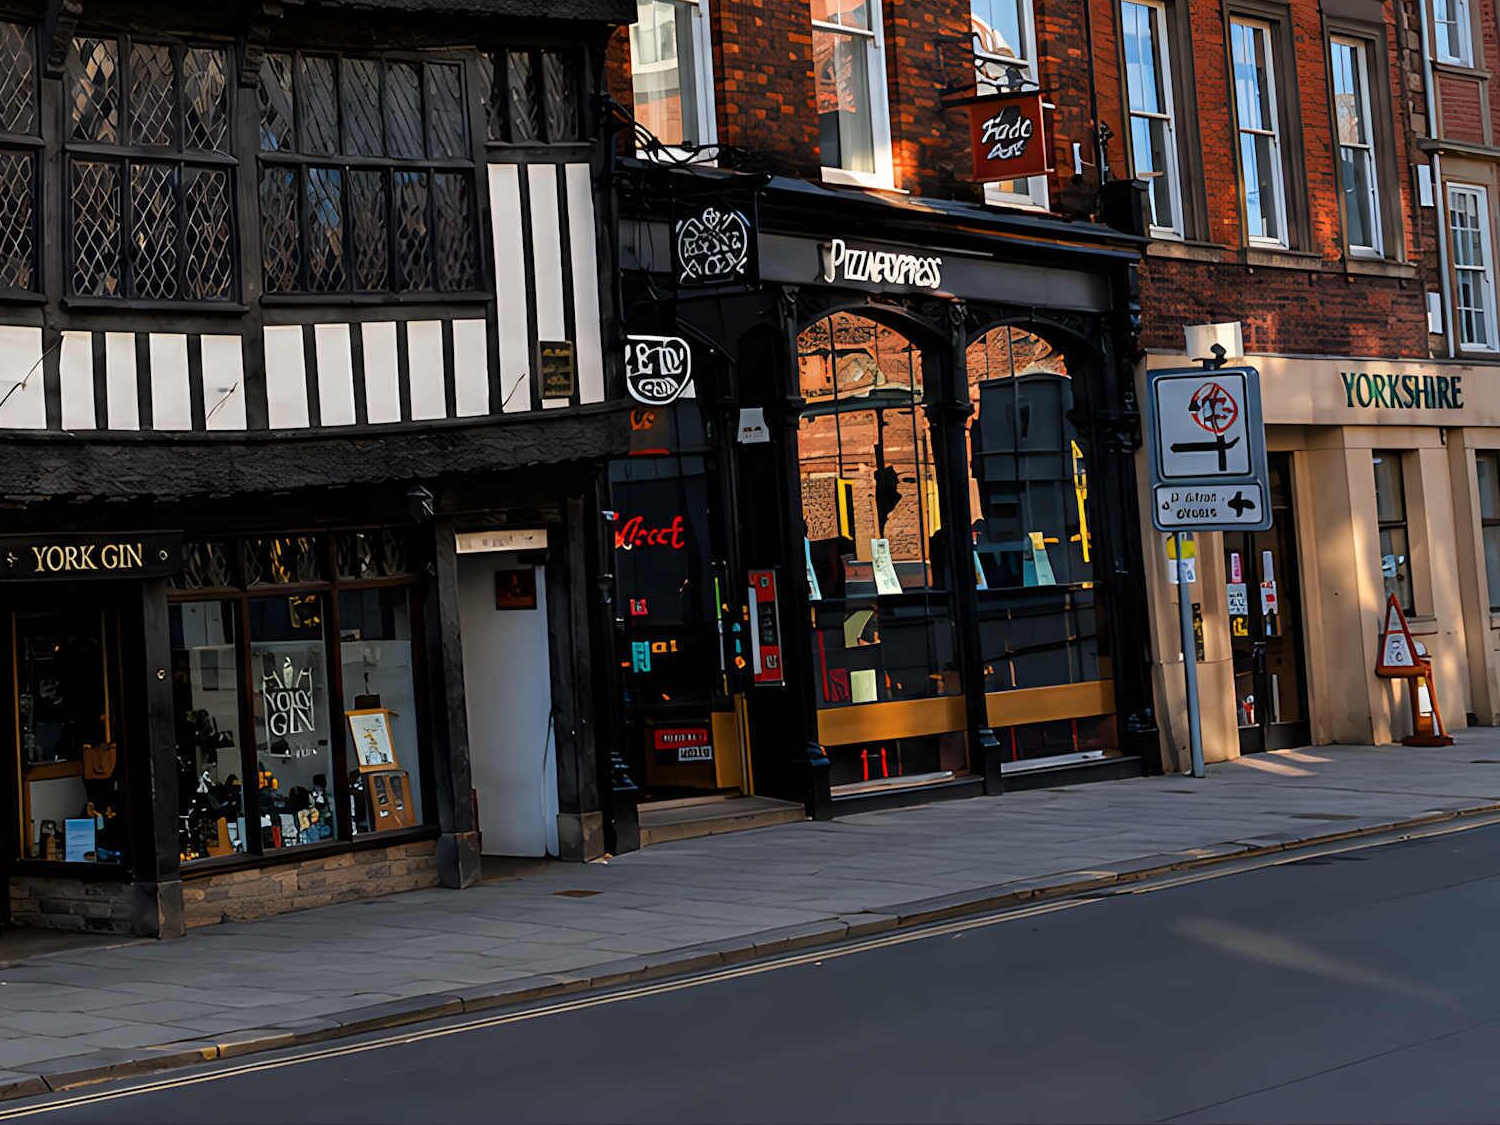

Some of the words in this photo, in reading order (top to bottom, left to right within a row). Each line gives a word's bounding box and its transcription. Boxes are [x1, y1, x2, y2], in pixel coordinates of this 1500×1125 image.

[1340, 372, 1464, 409] YORKSHIRE
[31, 545, 98, 572] YORK
[101, 542, 143, 569] GIN
